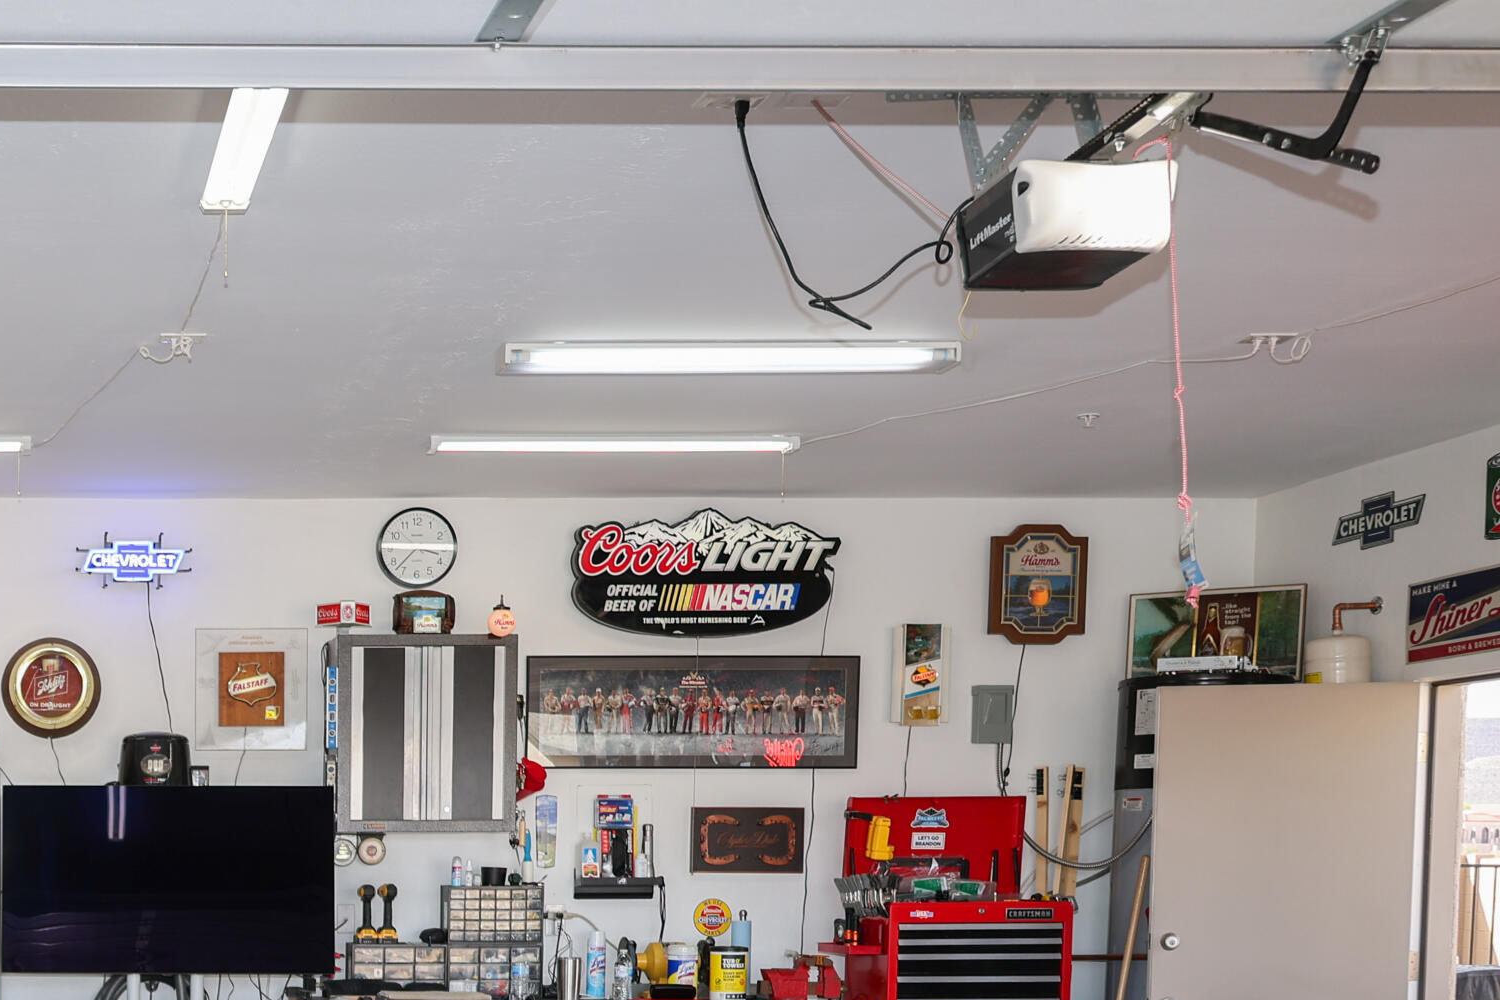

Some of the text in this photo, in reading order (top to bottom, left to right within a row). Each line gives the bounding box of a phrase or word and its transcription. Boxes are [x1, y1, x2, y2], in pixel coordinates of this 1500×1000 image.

[969, 213, 1012, 250] LiftMaster
[401, 521, 409, 529] 11
[412, 517, 423, 526] 12
[1340, 503, 1417, 537] CHEVROLET
[391, 531, 401, 540] 10
[437, 531, 444, 540] 2
[581, 526, 836, 576] Coors LIGHT
[91, 553, 177, 568] CHEVROLET
[390, 557, 397, 566] 8
[1021, 554, 1061, 566] Hamm's
[413, 570, 420, 579] 6
[426, 566, 433, 575] 5
[1412, 580, 1458, 596] MAKE MINE A
[607, 584, 794, 610] OFFICIAL NASCAR
[604, 600, 656, 612] BEER OF
[1410, 594, 1493, 645] Shiner
[233, 677, 269, 692] FALSTAFF
